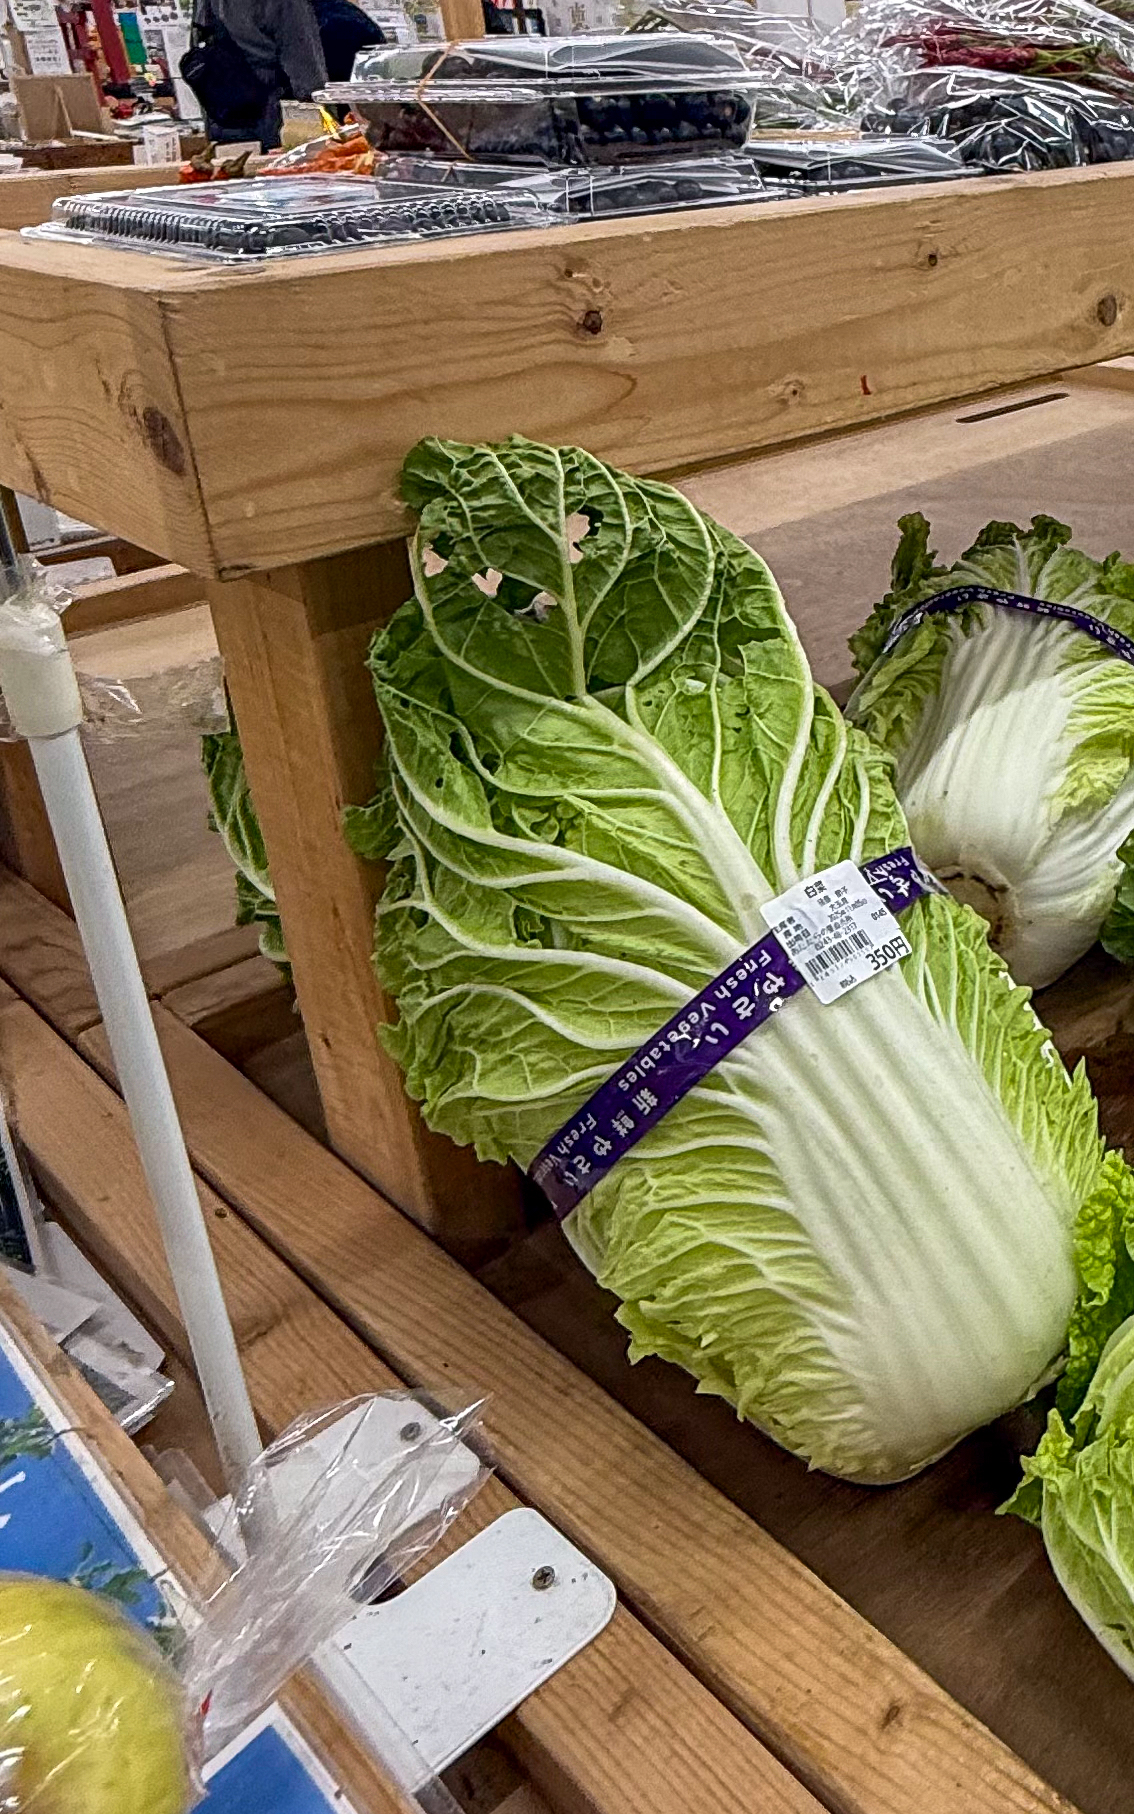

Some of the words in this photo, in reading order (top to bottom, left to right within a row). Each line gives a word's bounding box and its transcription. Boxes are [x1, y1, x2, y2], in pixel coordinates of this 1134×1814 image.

[804, 880, 828, 899] 白菜
[714, 949, 773, 1000] Fresh
[865, 935, 910, 971] 350円
[617, 1001, 717, 1092] Vegetables
[556, 1112, 598, 1155] Fresh
[563, 1087, 659, 1188] 新鮮やさい
